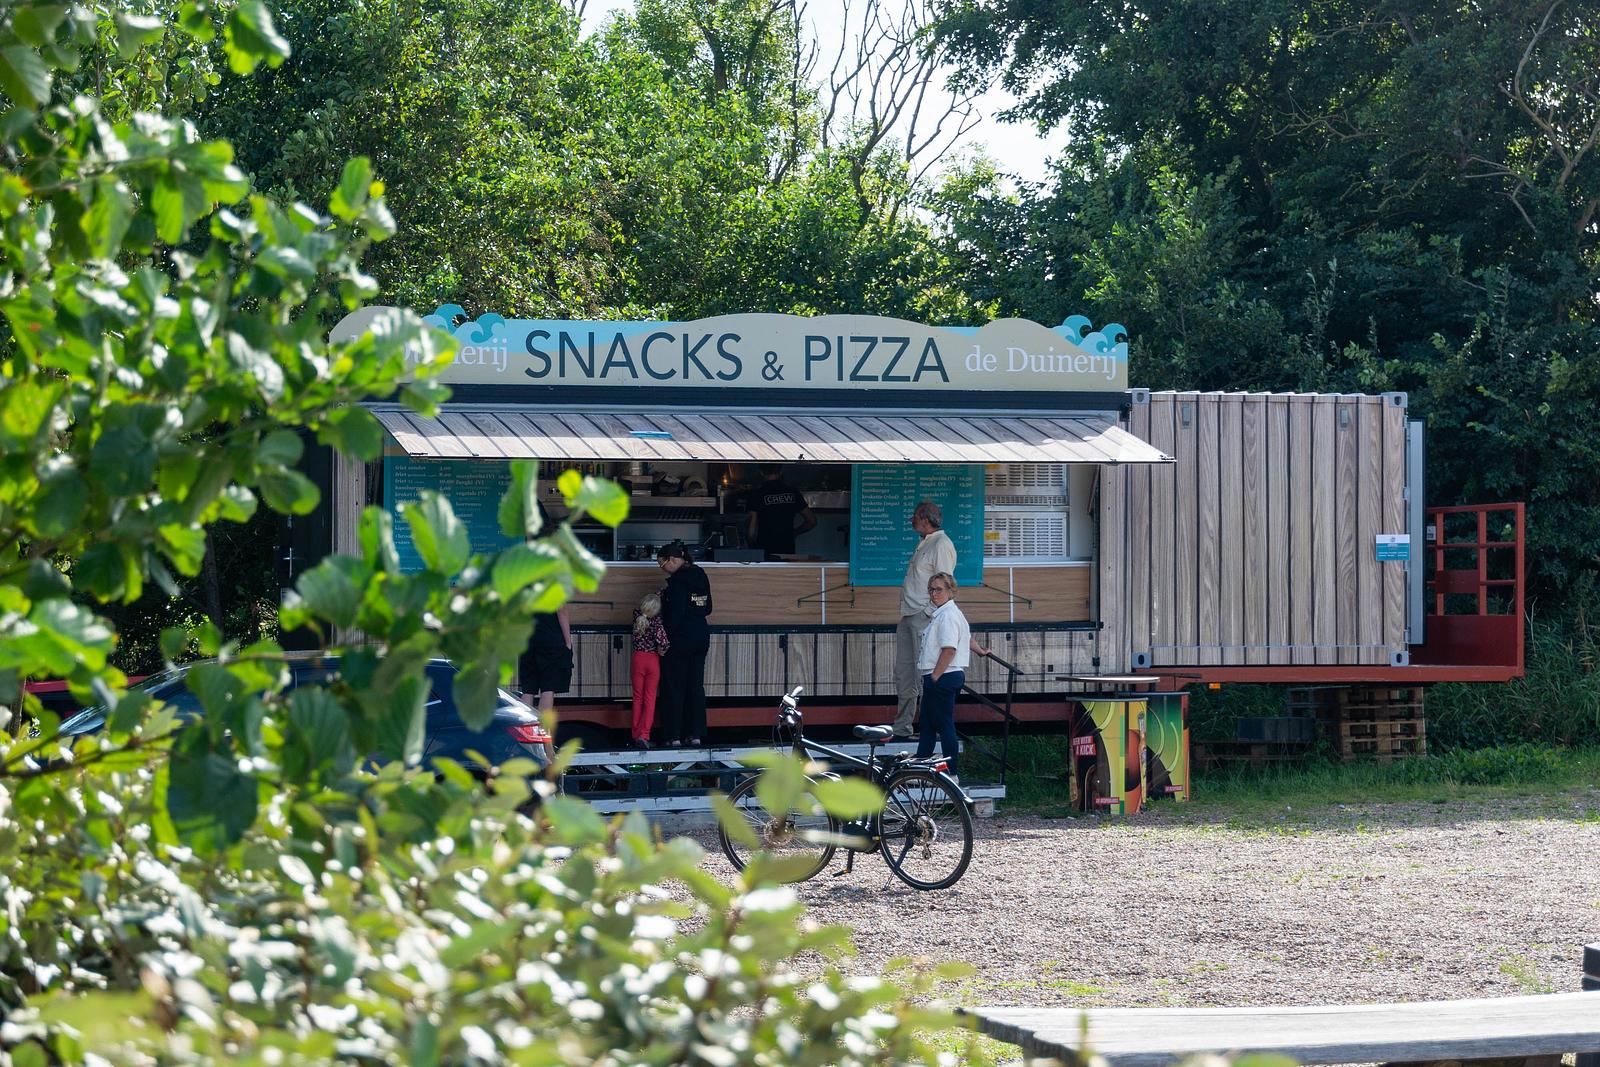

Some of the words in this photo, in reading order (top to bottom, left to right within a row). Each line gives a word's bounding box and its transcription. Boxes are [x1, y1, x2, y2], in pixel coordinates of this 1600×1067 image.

[524, 329, 743, 382] SNACKS
[761, 350, 785, 382] &
[804, 335, 950, 384] PIZZA
[965, 345, 998, 373] de
[1007, 347, 1118, 380] Duinerij
[766, 495, 793, 503] CREW
